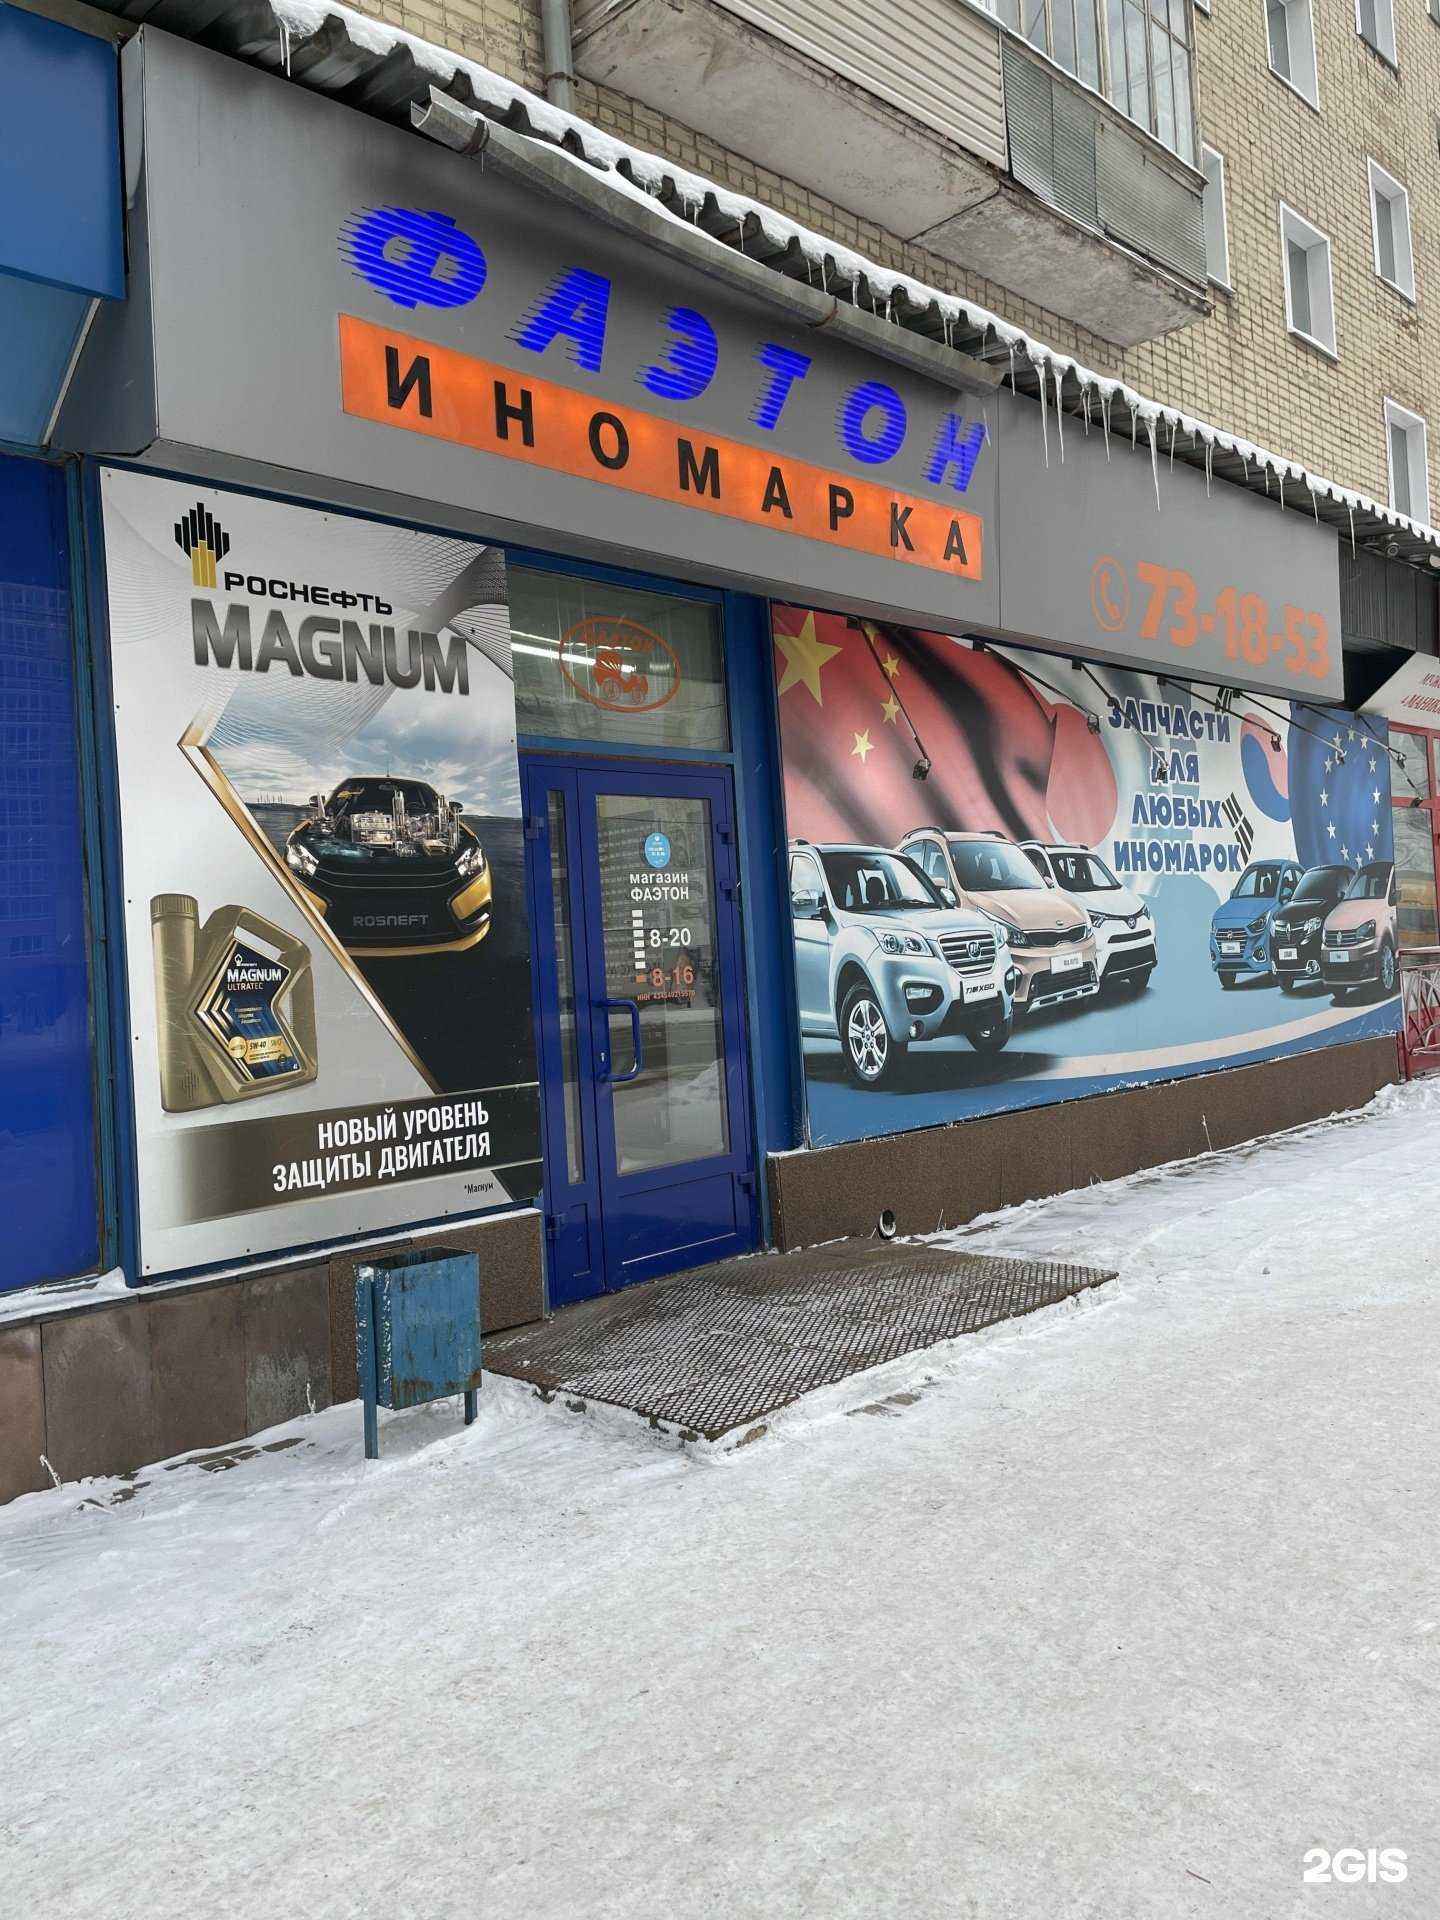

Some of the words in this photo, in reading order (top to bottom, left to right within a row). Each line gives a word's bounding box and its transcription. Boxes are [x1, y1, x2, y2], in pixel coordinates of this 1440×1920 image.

[336, 204, 991, 493] ФАЭТОН
[385, 344, 969, 566] ИНОМАРКА
[224, 571, 393, 616] РОСНЕФТЬ
[1136, 559, 1331, 680] 73-18-53
[191, 598, 470, 696] MAGNUM
[1107, 697, 1231, 743] ЗАПЧАСТИ
[1151, 749, 1200, 784] ДЛЯ
[1132, 793, 1224, 829] ЛЮБЫХ
[1114, 840, 1241, 873] ИНОМАРОК
[629, 872, 689, 884] магазин
[630, 886, 689, 902] ФАЭТОН
[352, 913, 429, 927] ROSNEFT
[650, 927, 691, 948] 8-20
[227, 968, 282, 982] MAGNUM
[227, 981, 264, 991] ULTRATEC
[652, 965, 694, 988] 8-16
[318, 1107, 397, 1150] НОВЫЙ
[403, 1101, 489, 1141] УРОВЕНЬ
[272, 1150, 371, 1192] ЗАЩИТЫ
[378, 1132, 491, 1180] ДВИГАТЕЛЯ
